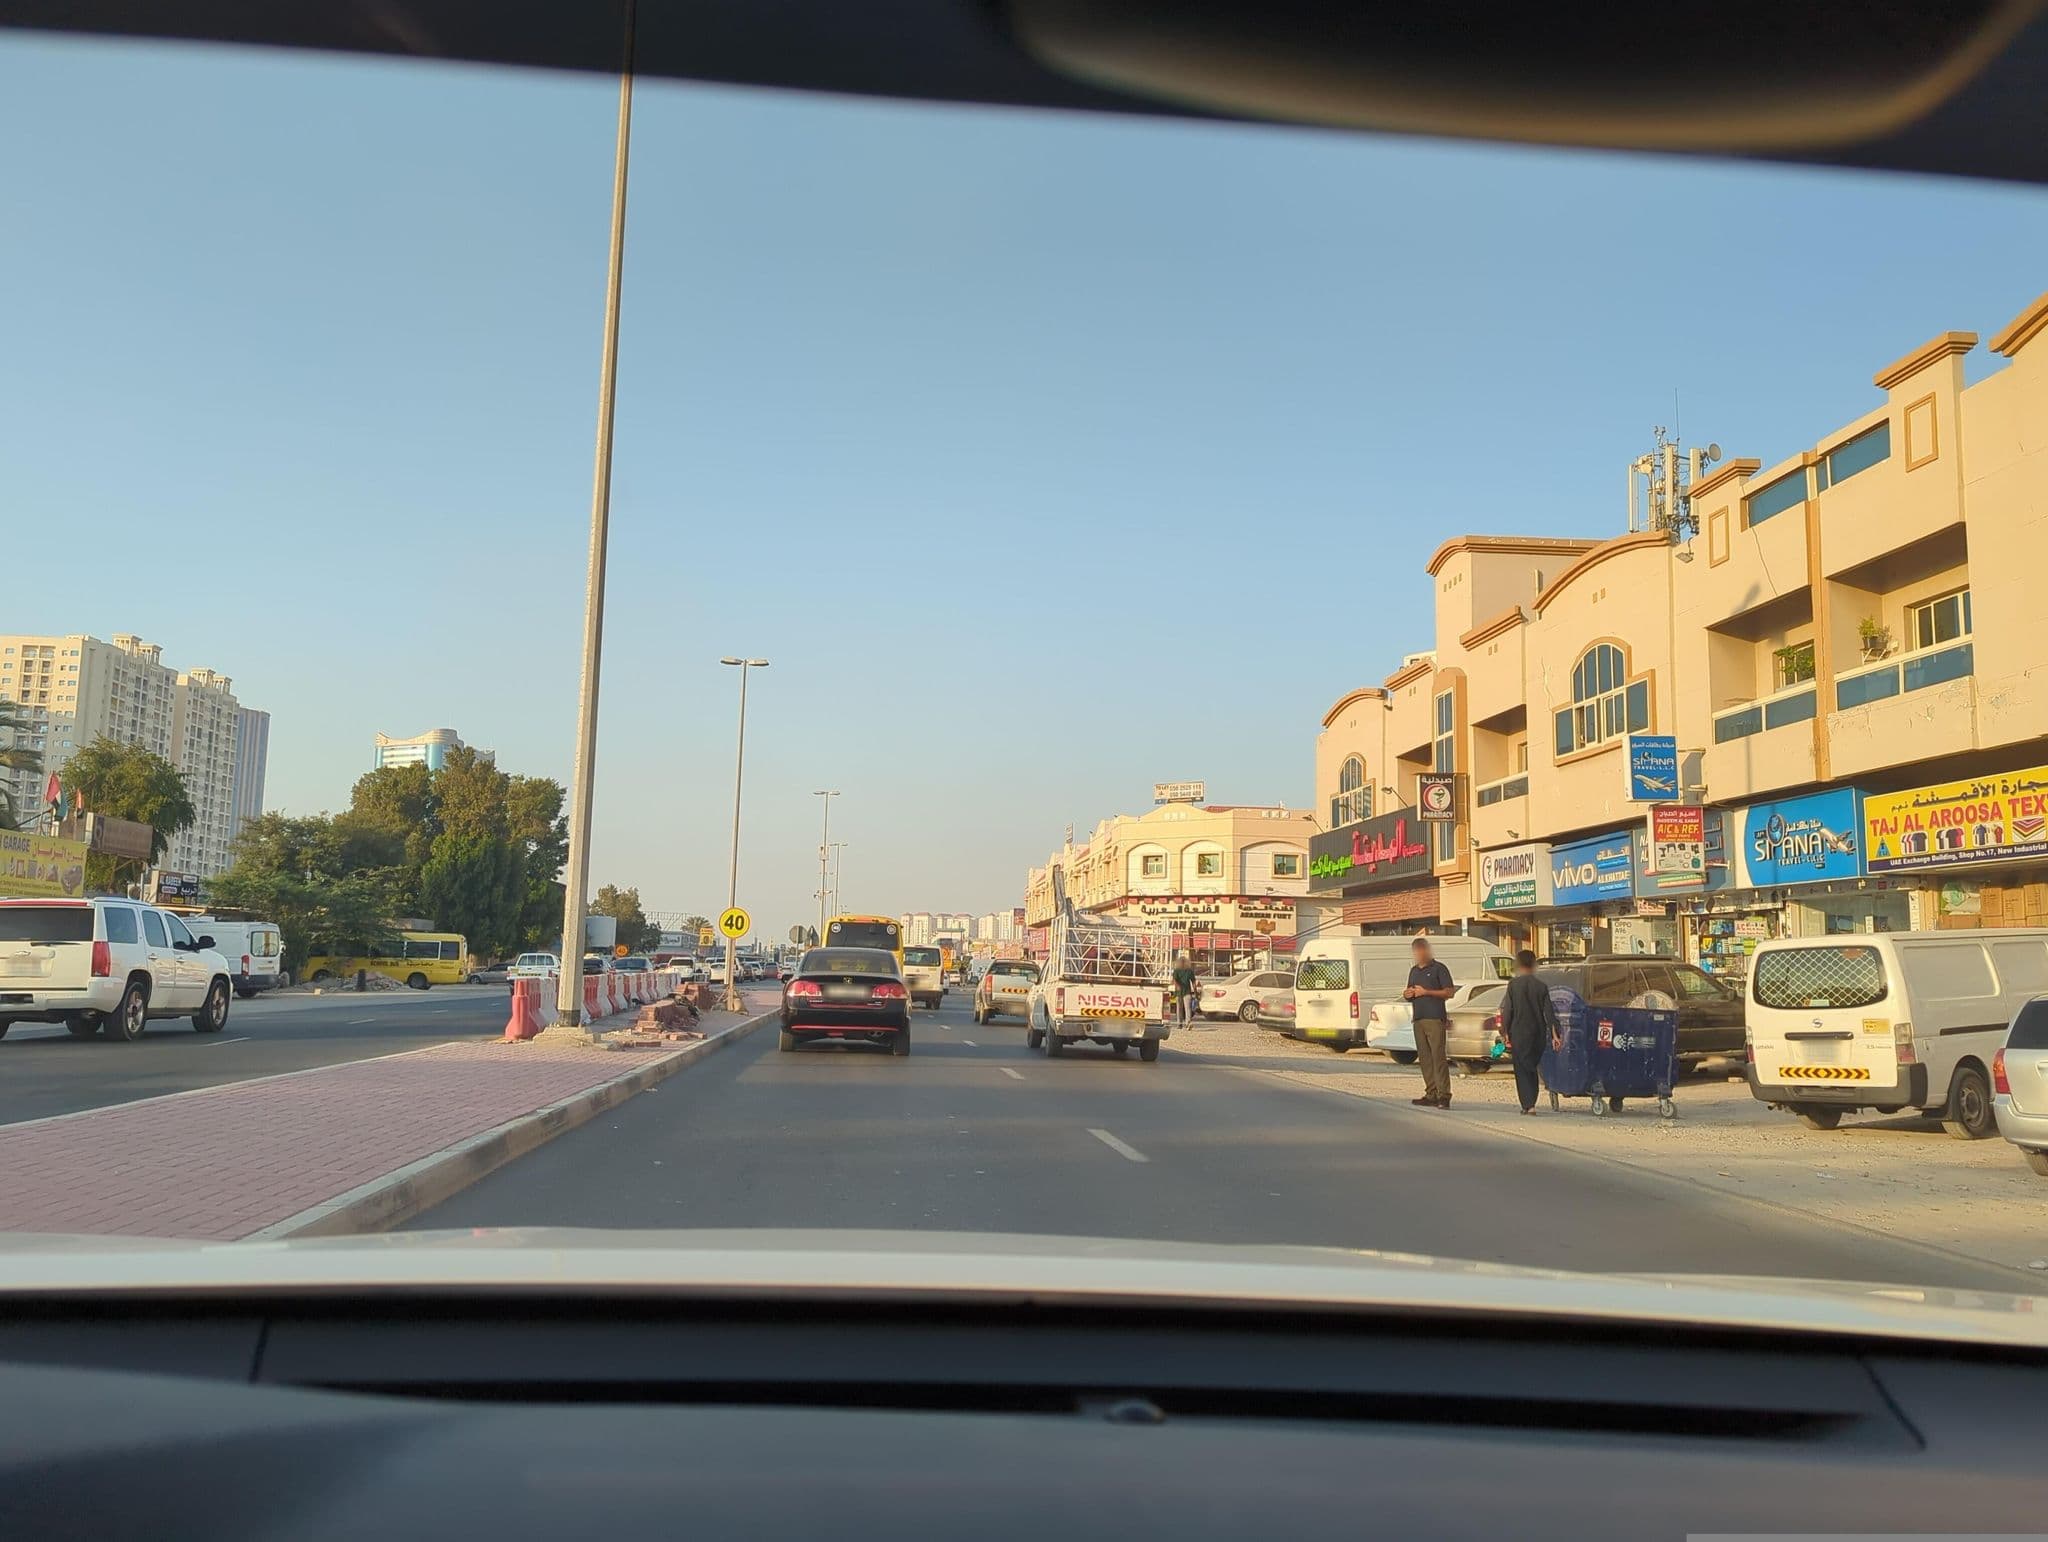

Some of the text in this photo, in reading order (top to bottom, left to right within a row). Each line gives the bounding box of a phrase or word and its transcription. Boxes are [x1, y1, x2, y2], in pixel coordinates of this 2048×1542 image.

[1422, 776, 1453, 784] صيدلية
[1870, 816, 1898, 837] TAJ
[1904, 813, 1924, 832] AL
[1929, 801, 2003, 829] AROOSA
[1657, 823, 1673, 834] A/C
[3, 835, 31, 853] GARAGE
[1903, 856, 1931, 865] Exchange
[1958, 851, 1975, 860] Shop
[1997, 846, 2013, 855] New
[2014, 843, 2048, 853] Industrial
[1494, 852, 1535, 877] PHARMACY
[1494, 894, 1536, 906] NEW LIFE PHARMACY
[1141, 904, 1220, 915] القلعة العربية
[724, 914, 745, 931] 40
[1078, 994, 1149, 1008] NISSAN
